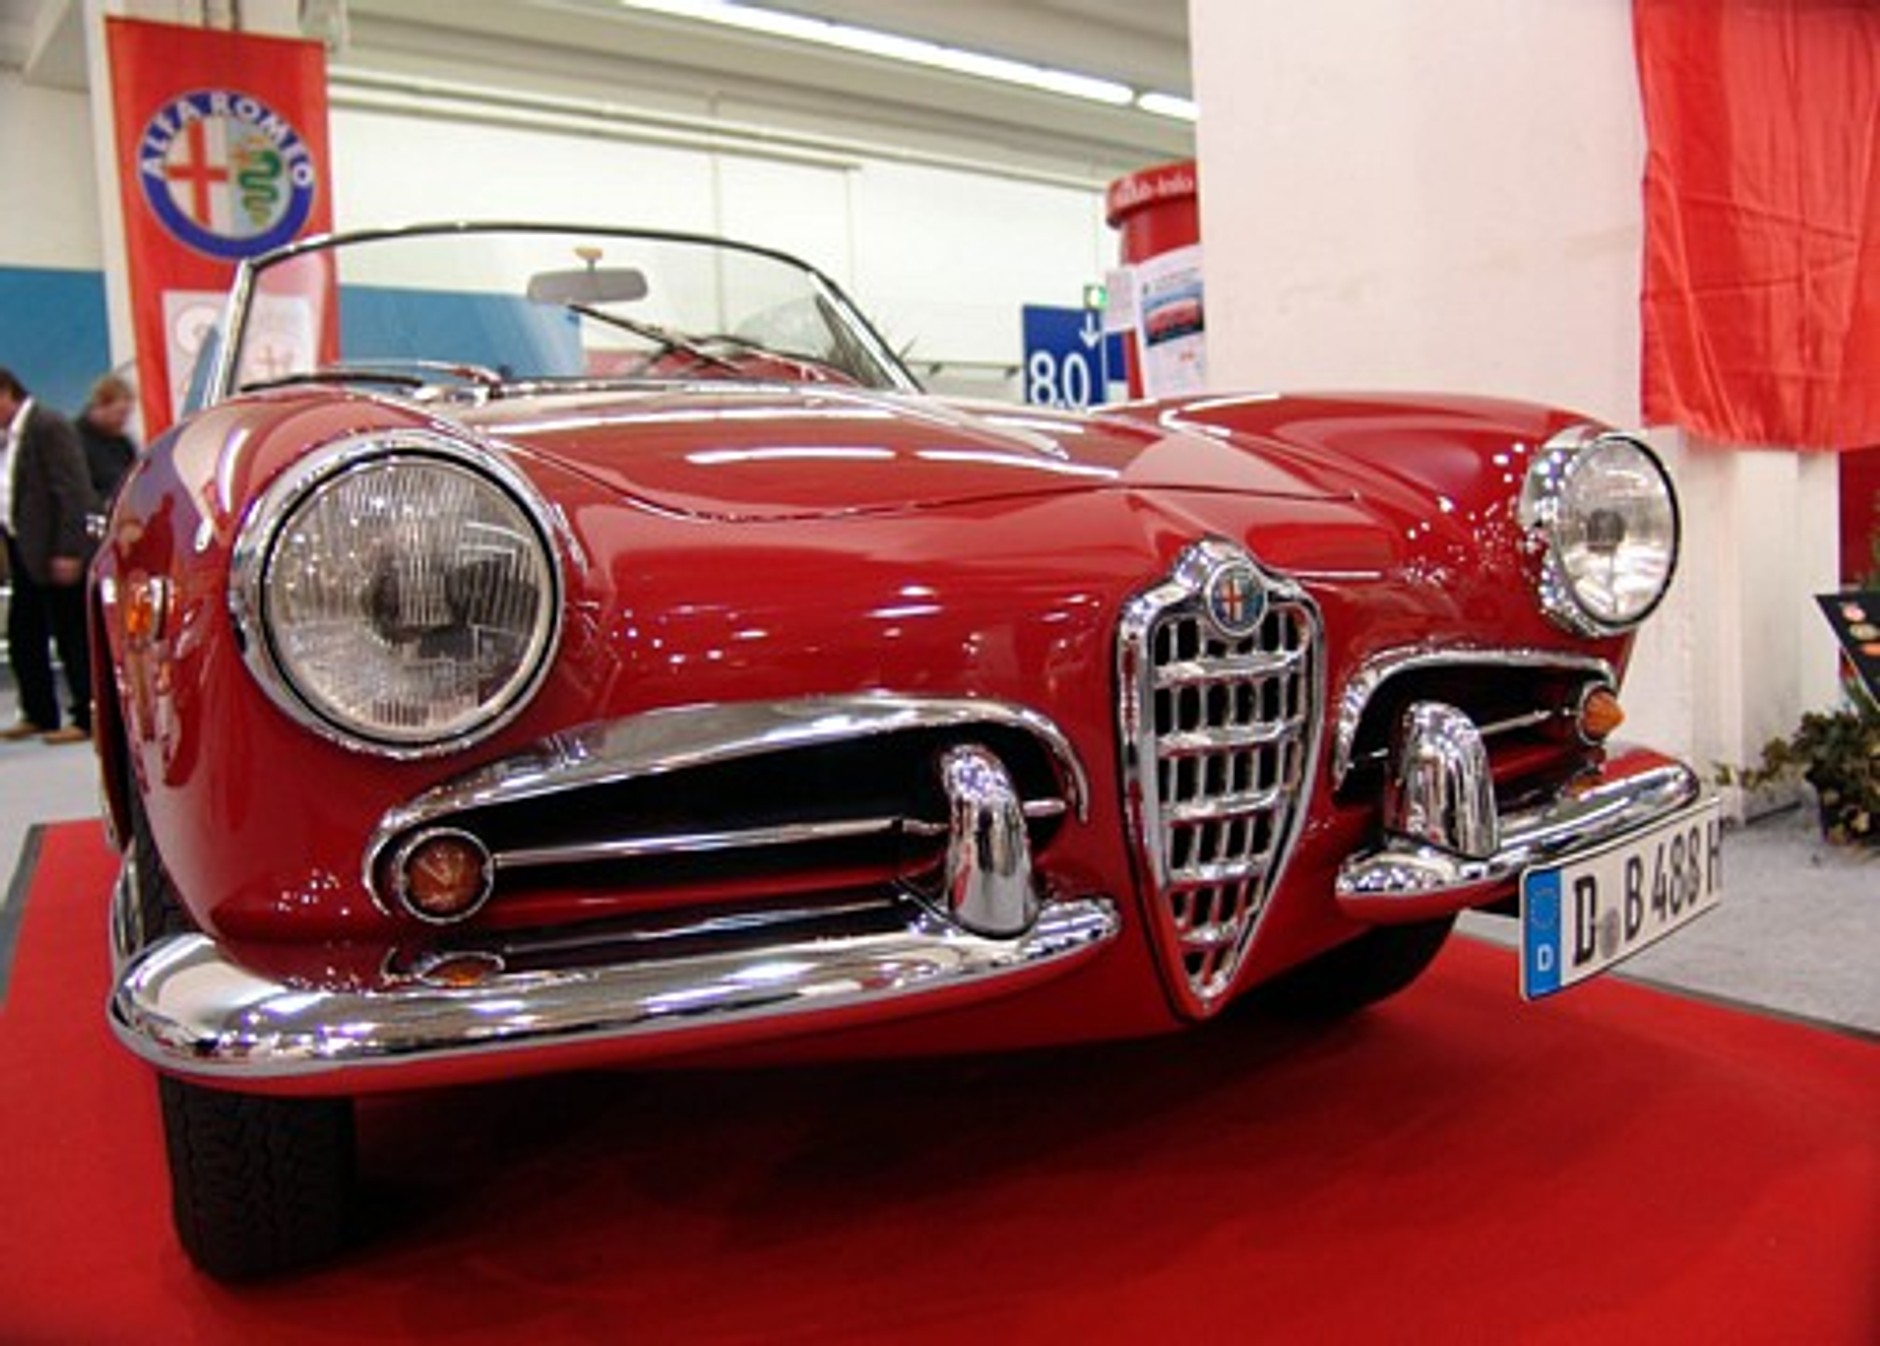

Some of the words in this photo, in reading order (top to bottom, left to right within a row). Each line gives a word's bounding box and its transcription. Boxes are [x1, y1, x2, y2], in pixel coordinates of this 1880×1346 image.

[142, 97, 201, 180] ALFA
[212, 92, 313, 187] ROMEO
[1537, 944, 1553, 971] D
[1574, 875, 1596, 966] D
